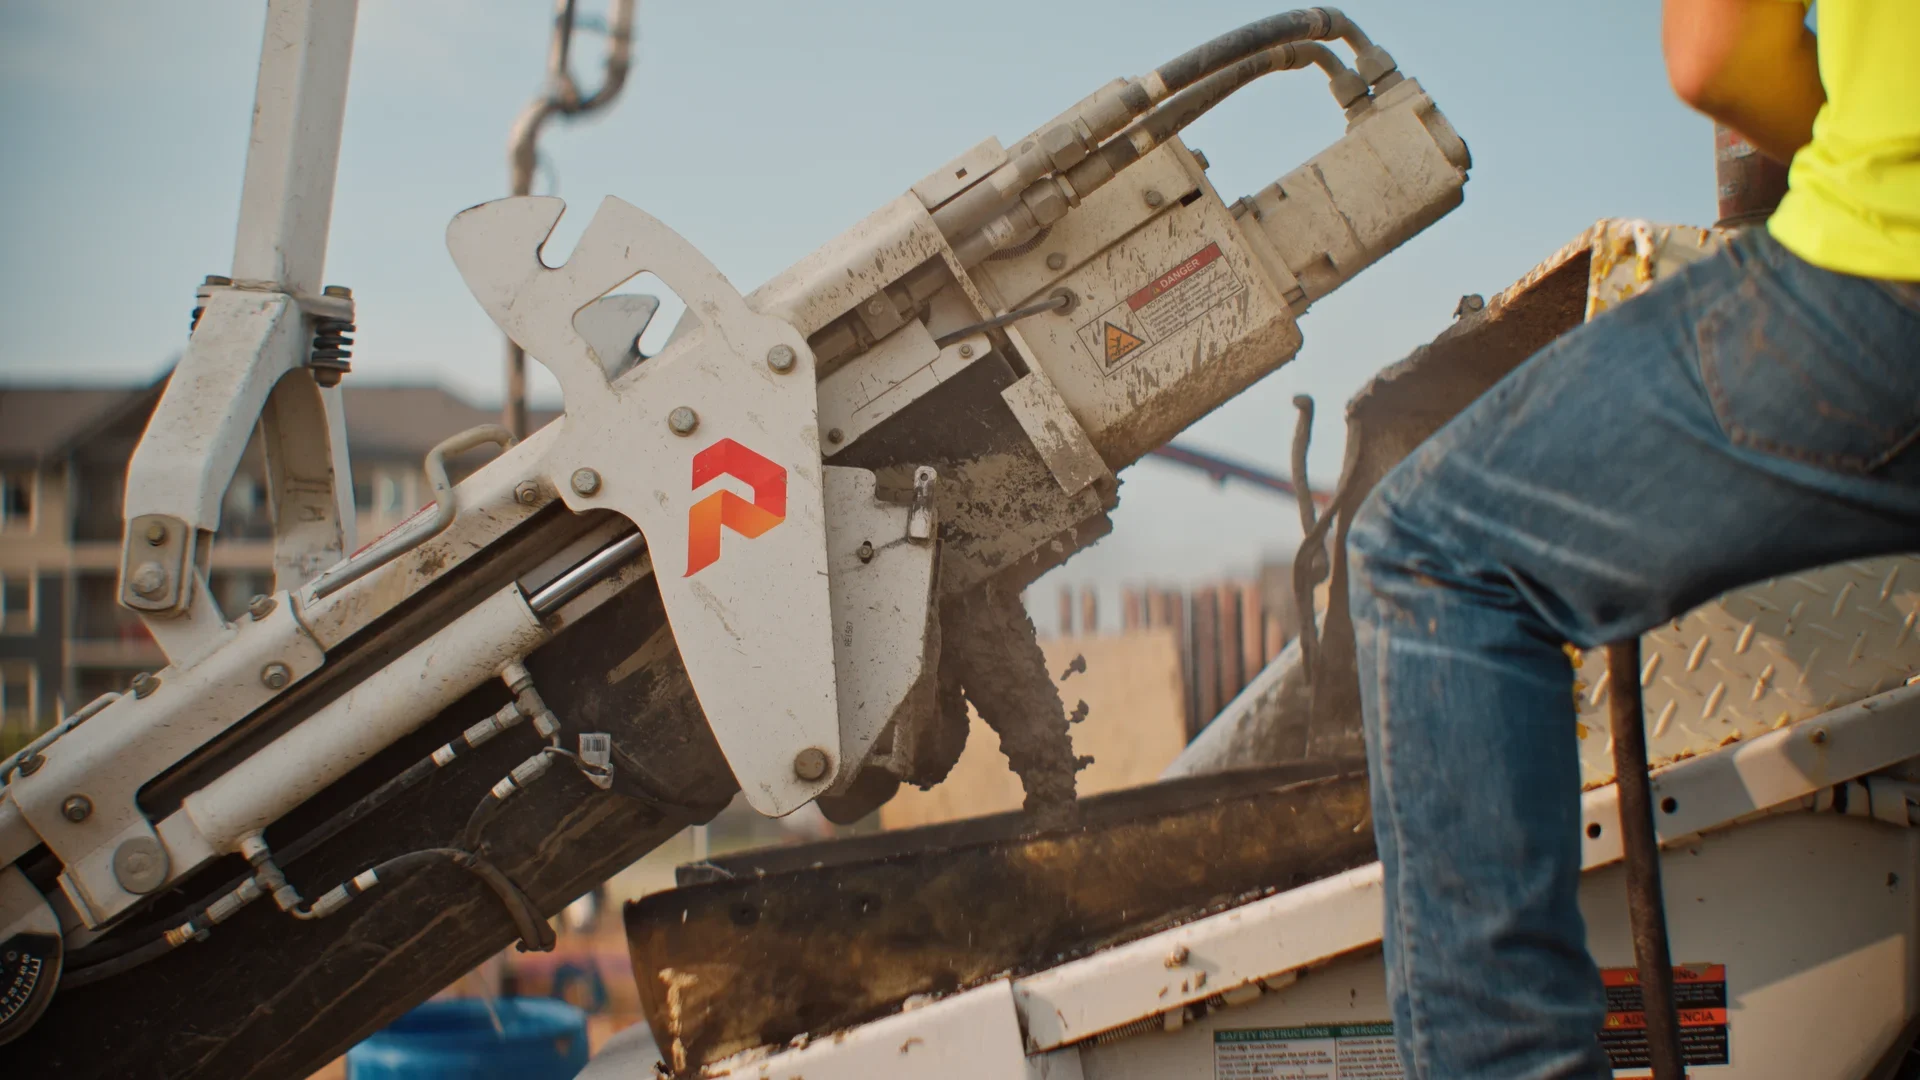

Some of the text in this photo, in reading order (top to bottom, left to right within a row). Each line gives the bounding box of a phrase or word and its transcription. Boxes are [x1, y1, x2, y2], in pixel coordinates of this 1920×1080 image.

[1160, 259, 1200, 288] DANGER
[1146, 290, 1174, 310] ROTATING
[1220, 1027, 1329, 1040] SAFETY INSTRUCTIONS
